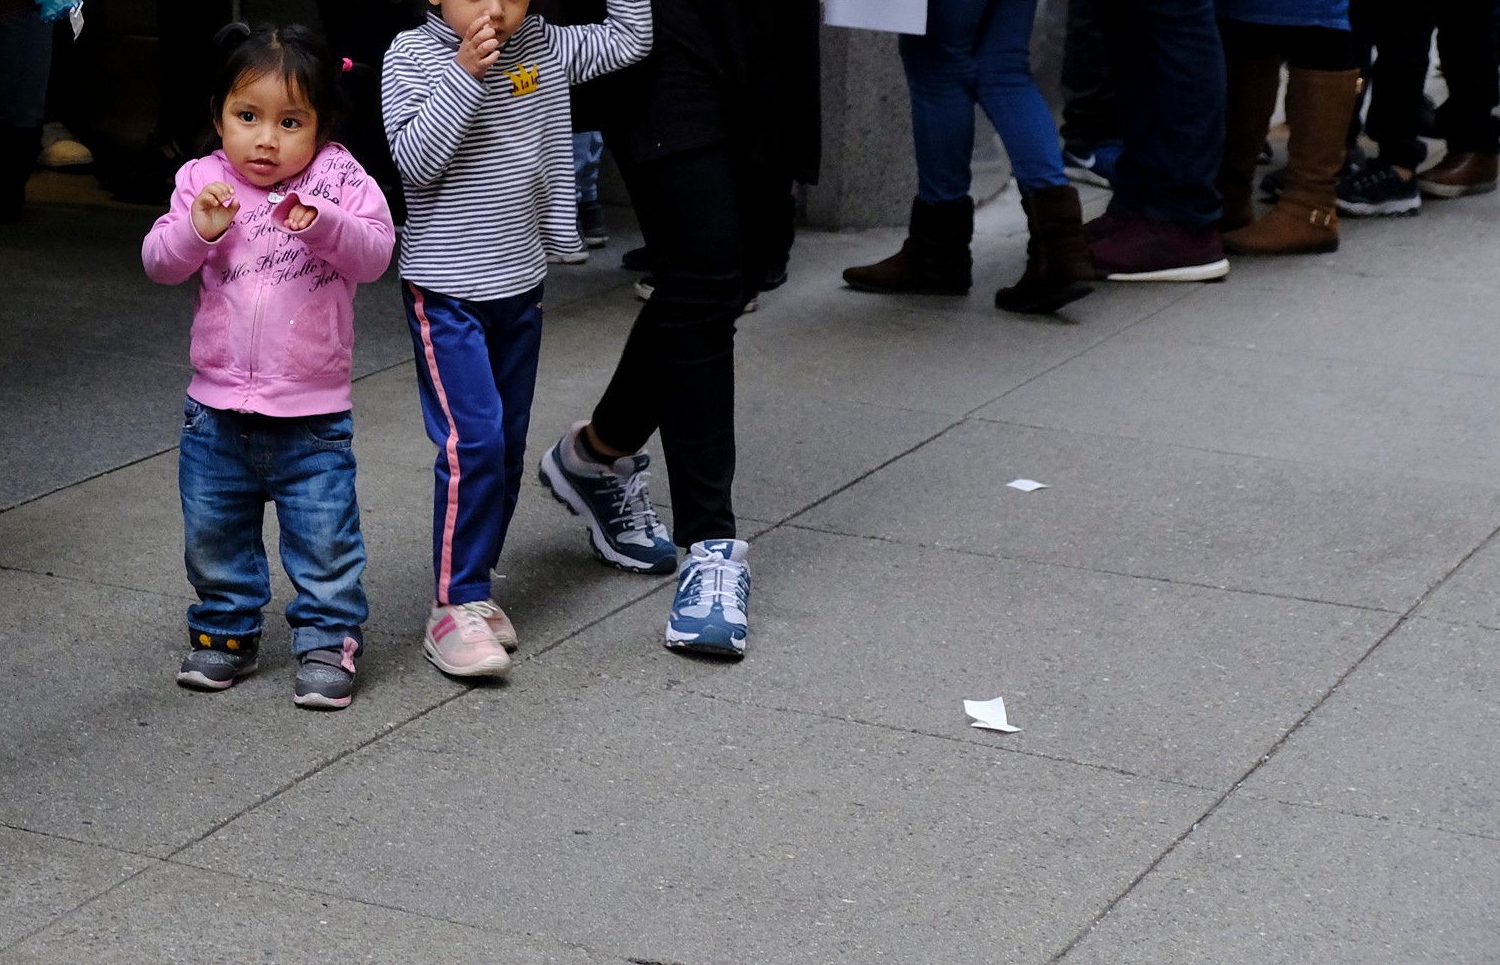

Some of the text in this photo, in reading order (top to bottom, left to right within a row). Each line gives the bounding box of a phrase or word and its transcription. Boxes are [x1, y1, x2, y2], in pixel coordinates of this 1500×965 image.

[336, 171, 364, 189] Kitt
[240, 203, 276, 225] Kitt
[255, 248, 301, 274] Kitty
[270, 257, 317, 287] Hello
